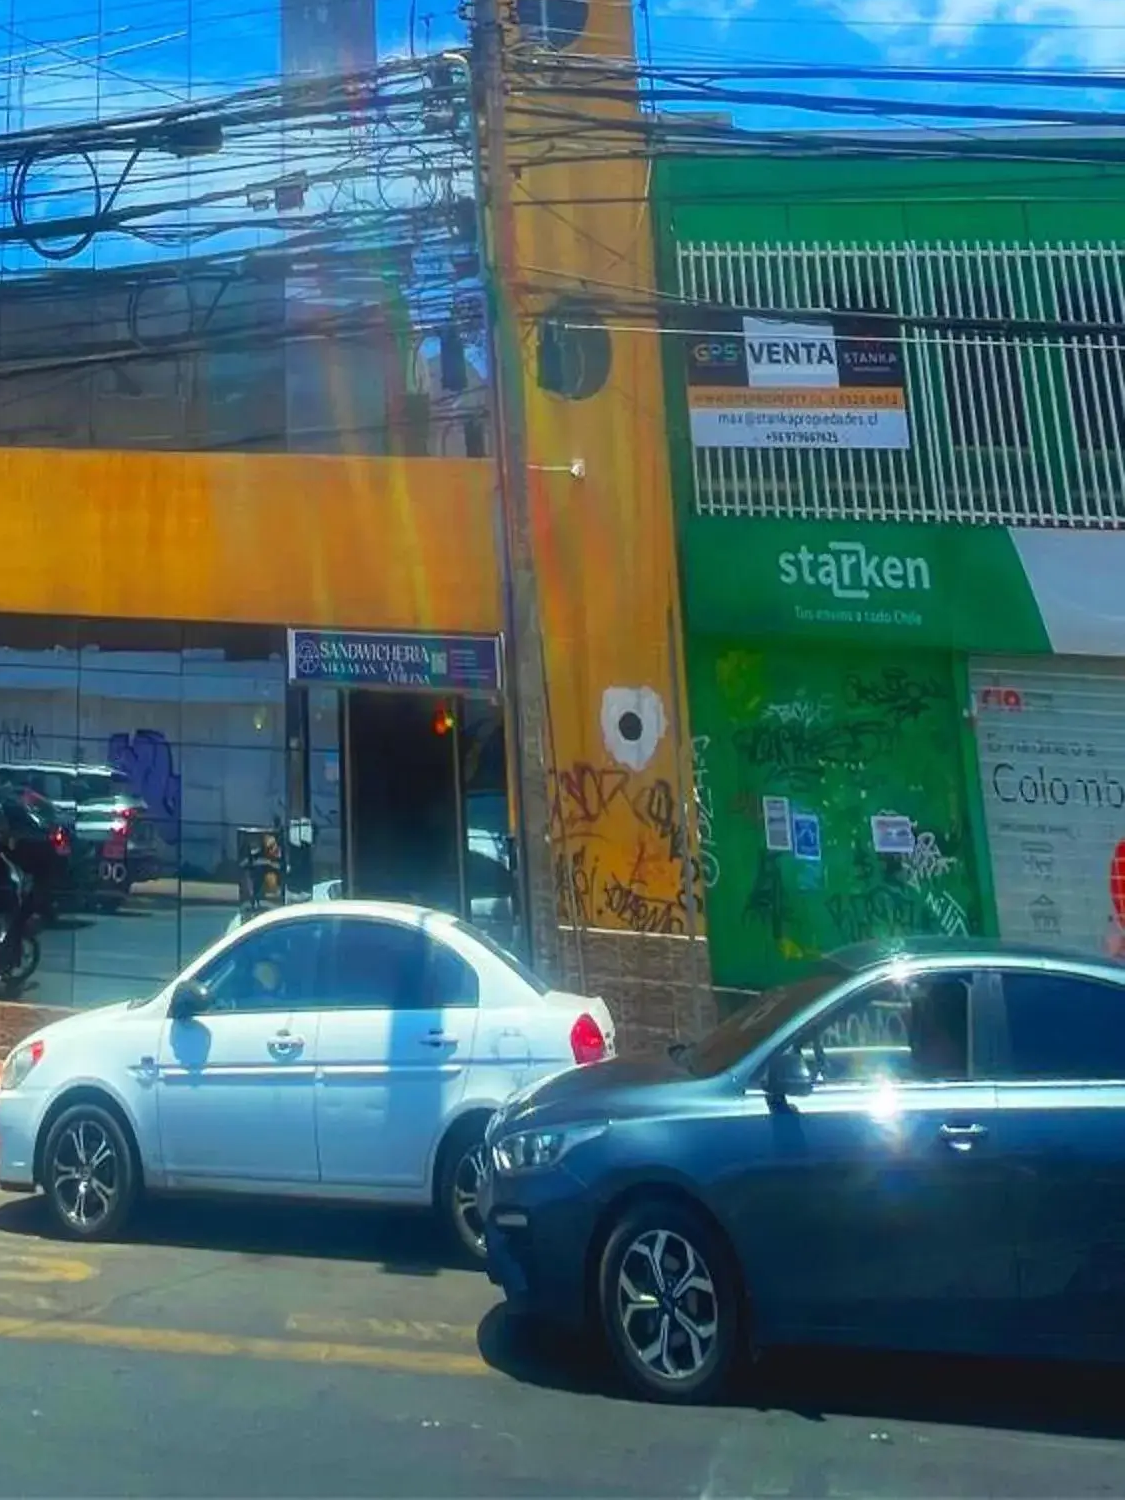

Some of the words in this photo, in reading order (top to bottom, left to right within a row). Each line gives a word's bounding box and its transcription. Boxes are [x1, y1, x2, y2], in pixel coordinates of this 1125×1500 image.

[748, 342, 835, 365] VENTA
[844, 352, 897, 364] STANKA
[779, 541, 931, 598] starken
